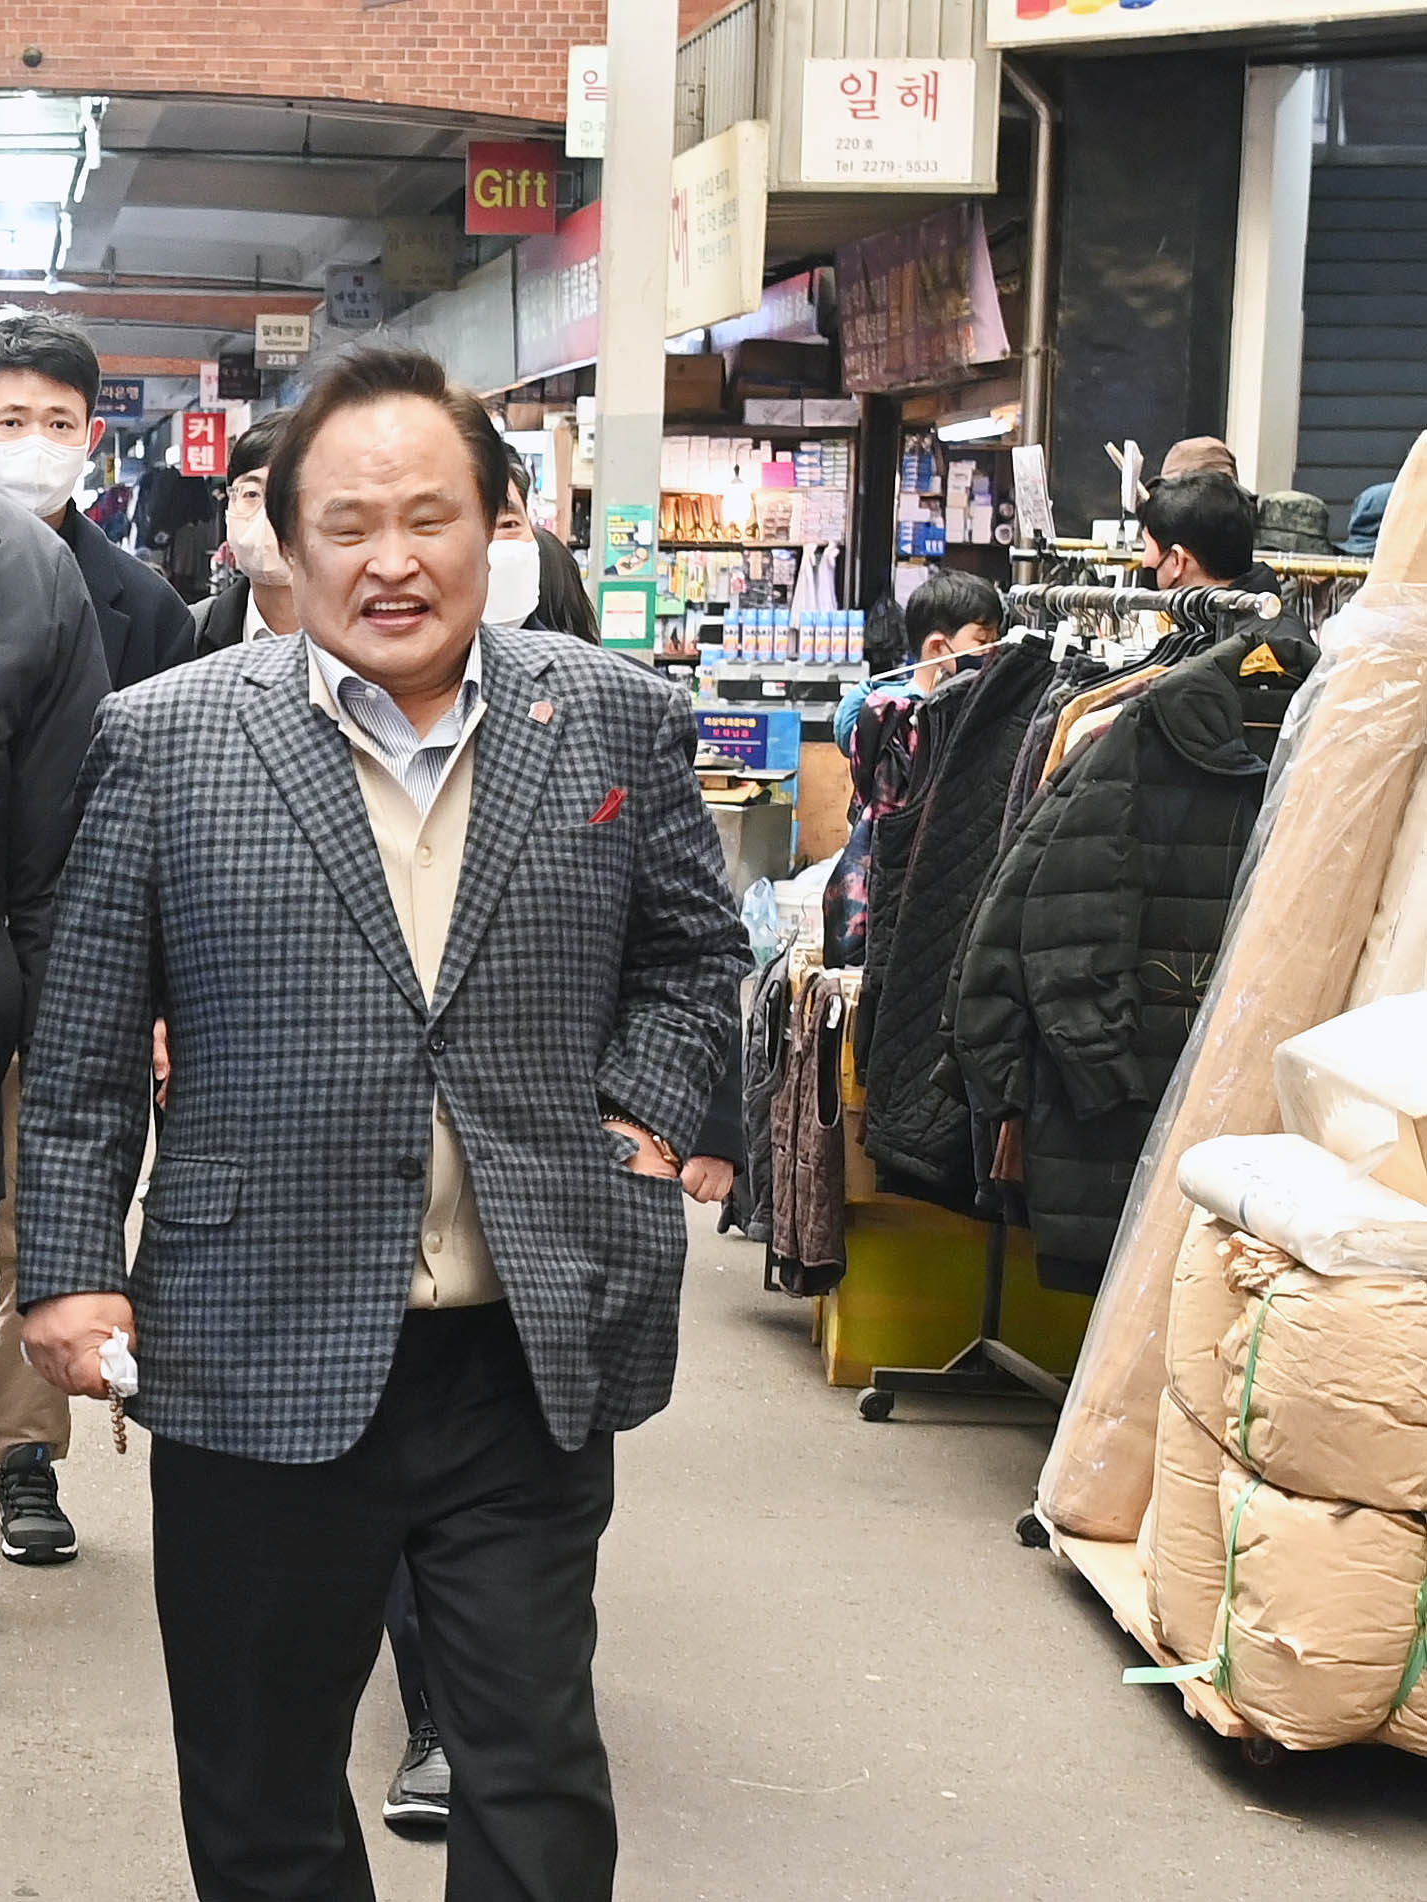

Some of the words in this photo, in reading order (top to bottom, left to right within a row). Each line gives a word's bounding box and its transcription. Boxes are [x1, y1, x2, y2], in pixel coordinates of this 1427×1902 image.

[835, 160, 854, 173] Tel
[474, 168, 548, 208] Gift
[186, 417, 215, 472] 커텐
